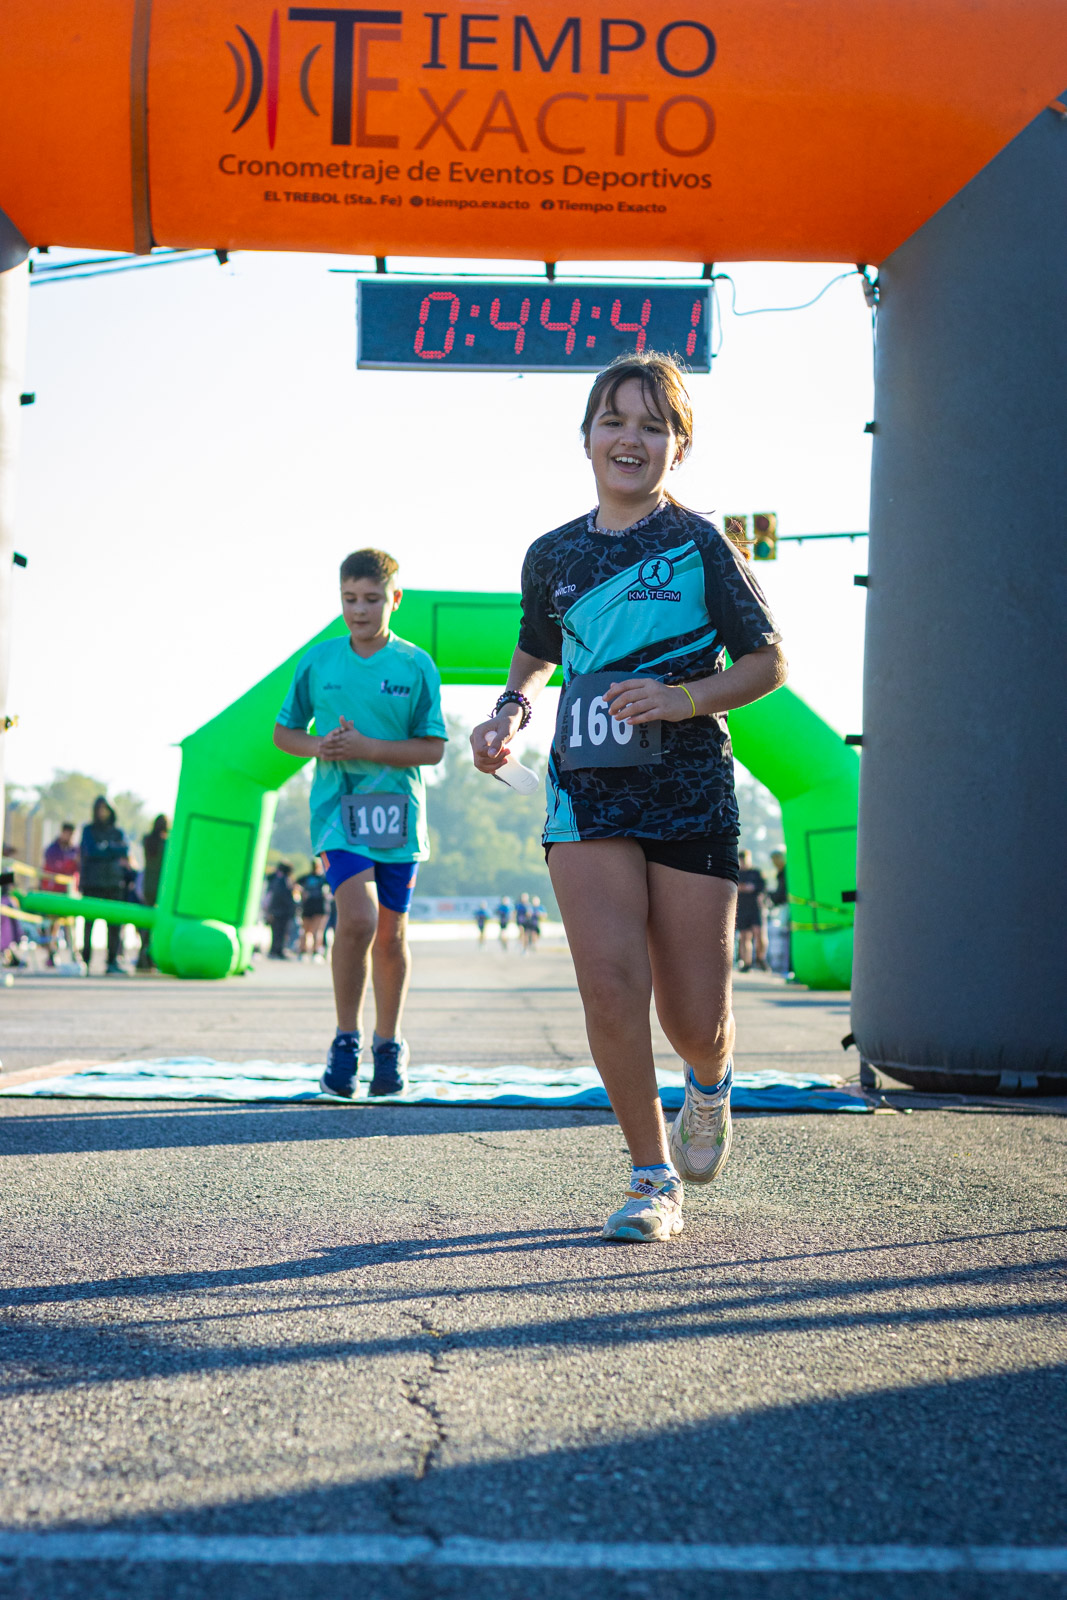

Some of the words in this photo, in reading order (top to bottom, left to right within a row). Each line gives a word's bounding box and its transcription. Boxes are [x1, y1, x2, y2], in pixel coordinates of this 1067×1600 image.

[356, 28, 716, 157] EXACTO
[218, 153, 400, 184] Cronometraje
[407, 160, 441, 181] de
[449, 161, 554, 184] Eventos
[563, 165, 712, 190] Deportivos
[264, 191, 281, 201] EL
[284, 191, 340, 204] TREBOL
[344, 193, 377, 205] (Sta.
[380, 195, 402, 206] Fe)
[425, 197, 530, 210] tiempo.exacto
[558, 200, 614, 213] Tiempo
[617, 201, 667, 213] Exacto
[649, 590, 681, 602] TEAM
[569, 695, 634, 748] 166
[357, 805, 401, 835] 102
